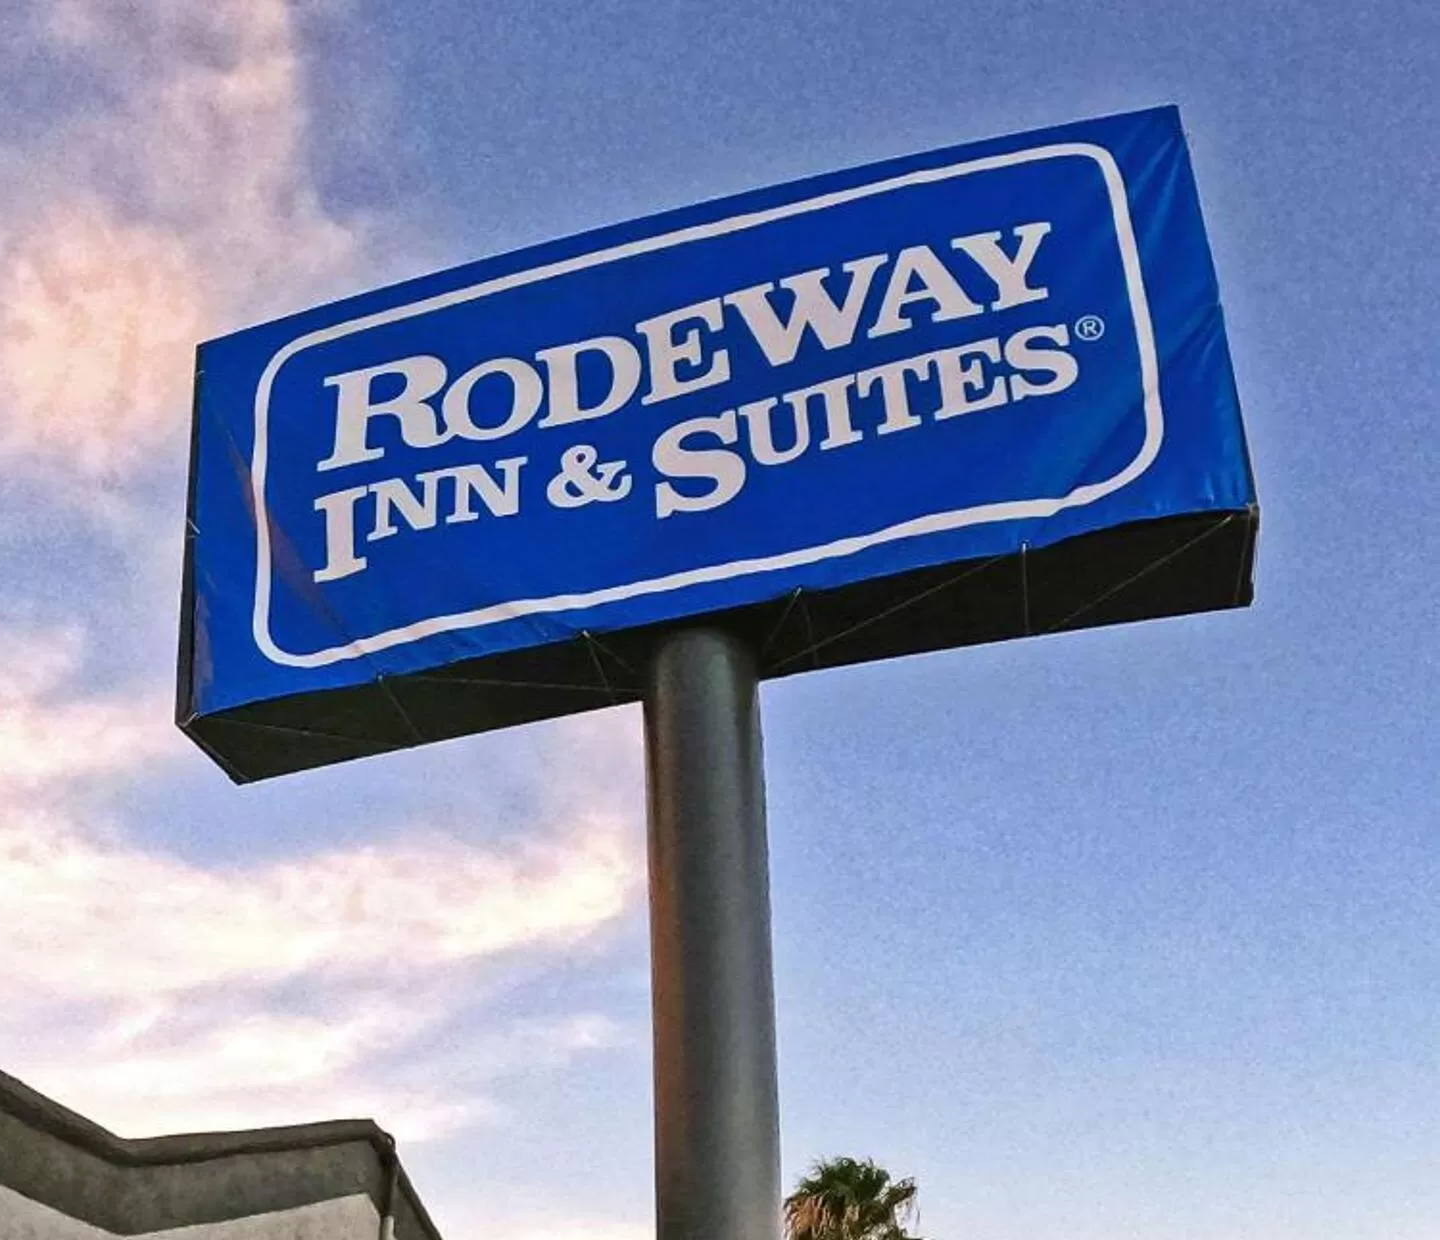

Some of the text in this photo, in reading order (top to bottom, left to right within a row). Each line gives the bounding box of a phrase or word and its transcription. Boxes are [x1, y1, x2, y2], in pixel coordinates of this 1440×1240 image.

[317, 222, 1051, 472] RODEWAY
[313, 456, 527, 583] INN
[546, 444, 632, 508] &
